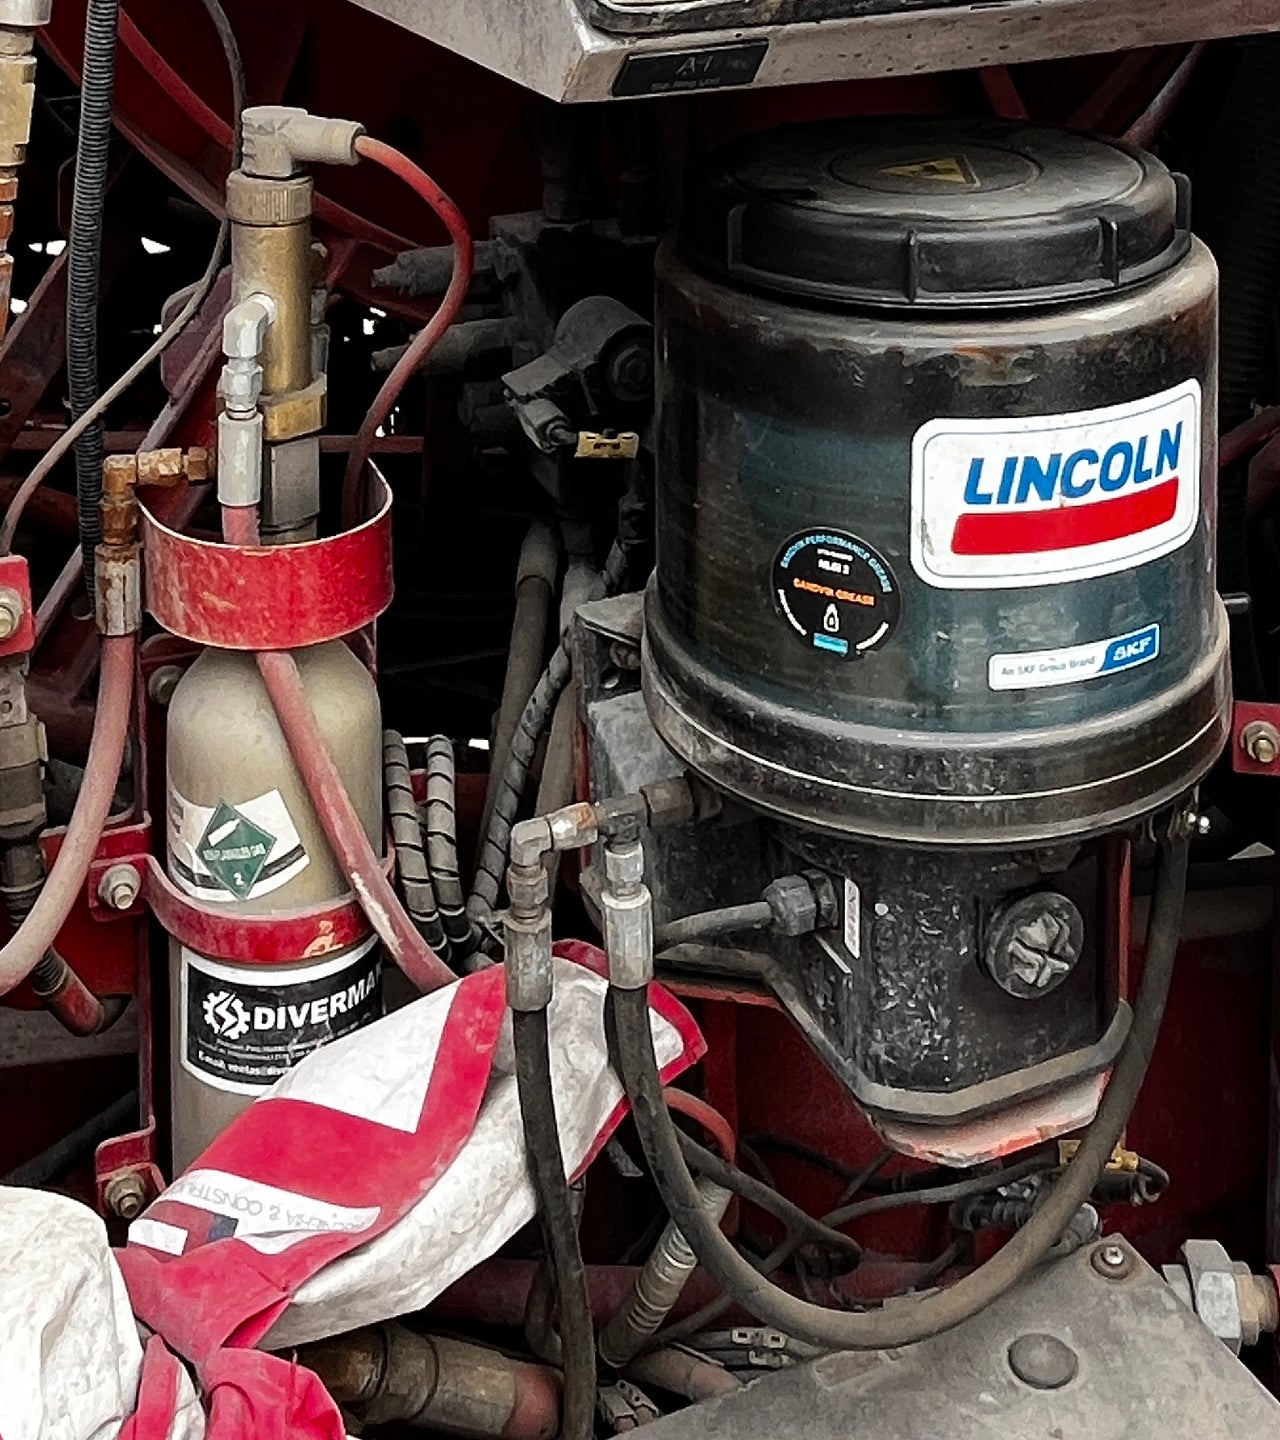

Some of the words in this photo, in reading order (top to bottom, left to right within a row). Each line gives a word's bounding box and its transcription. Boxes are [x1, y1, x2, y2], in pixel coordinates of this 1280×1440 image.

[964, 421, 1183, 505] LINCOLN
[1113, 636, 1152, 661] SKF
[233, 873, 245, 886] 2
